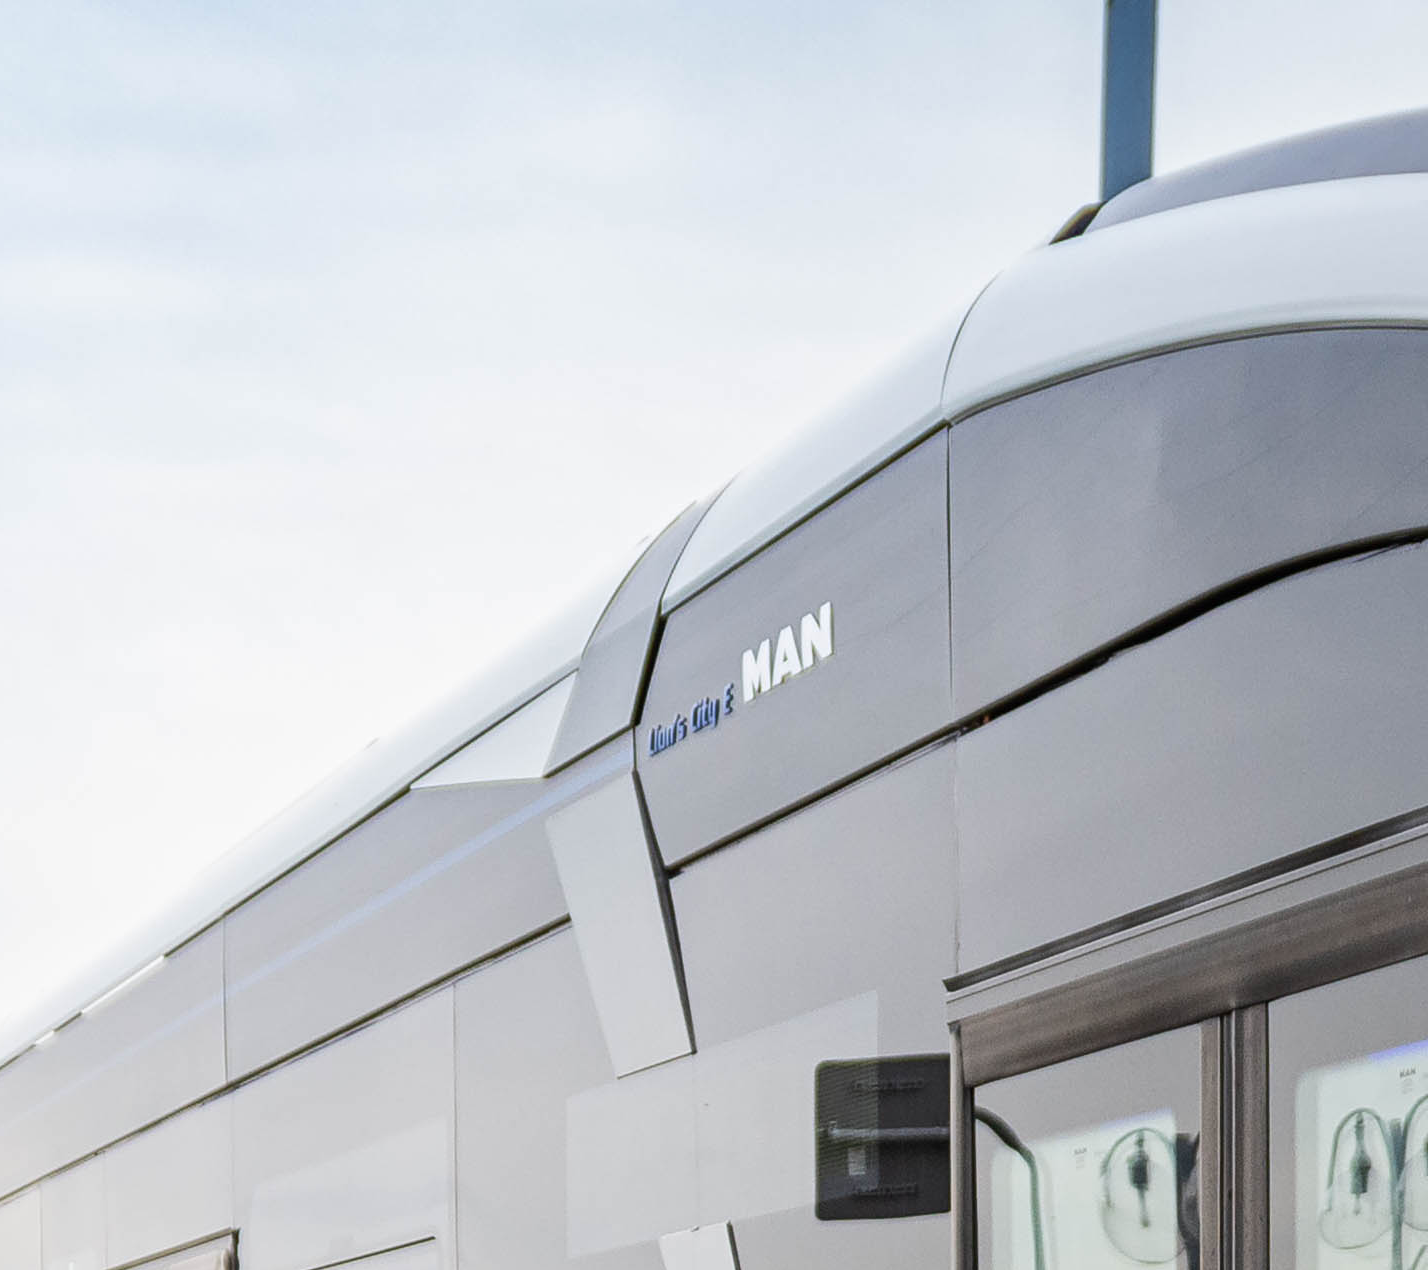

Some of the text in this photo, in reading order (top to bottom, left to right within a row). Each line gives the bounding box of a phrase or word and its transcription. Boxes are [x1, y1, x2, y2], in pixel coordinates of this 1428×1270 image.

[741, 600, 834, 703] MAN
[648, 682, 735, 757] Lion's City E
